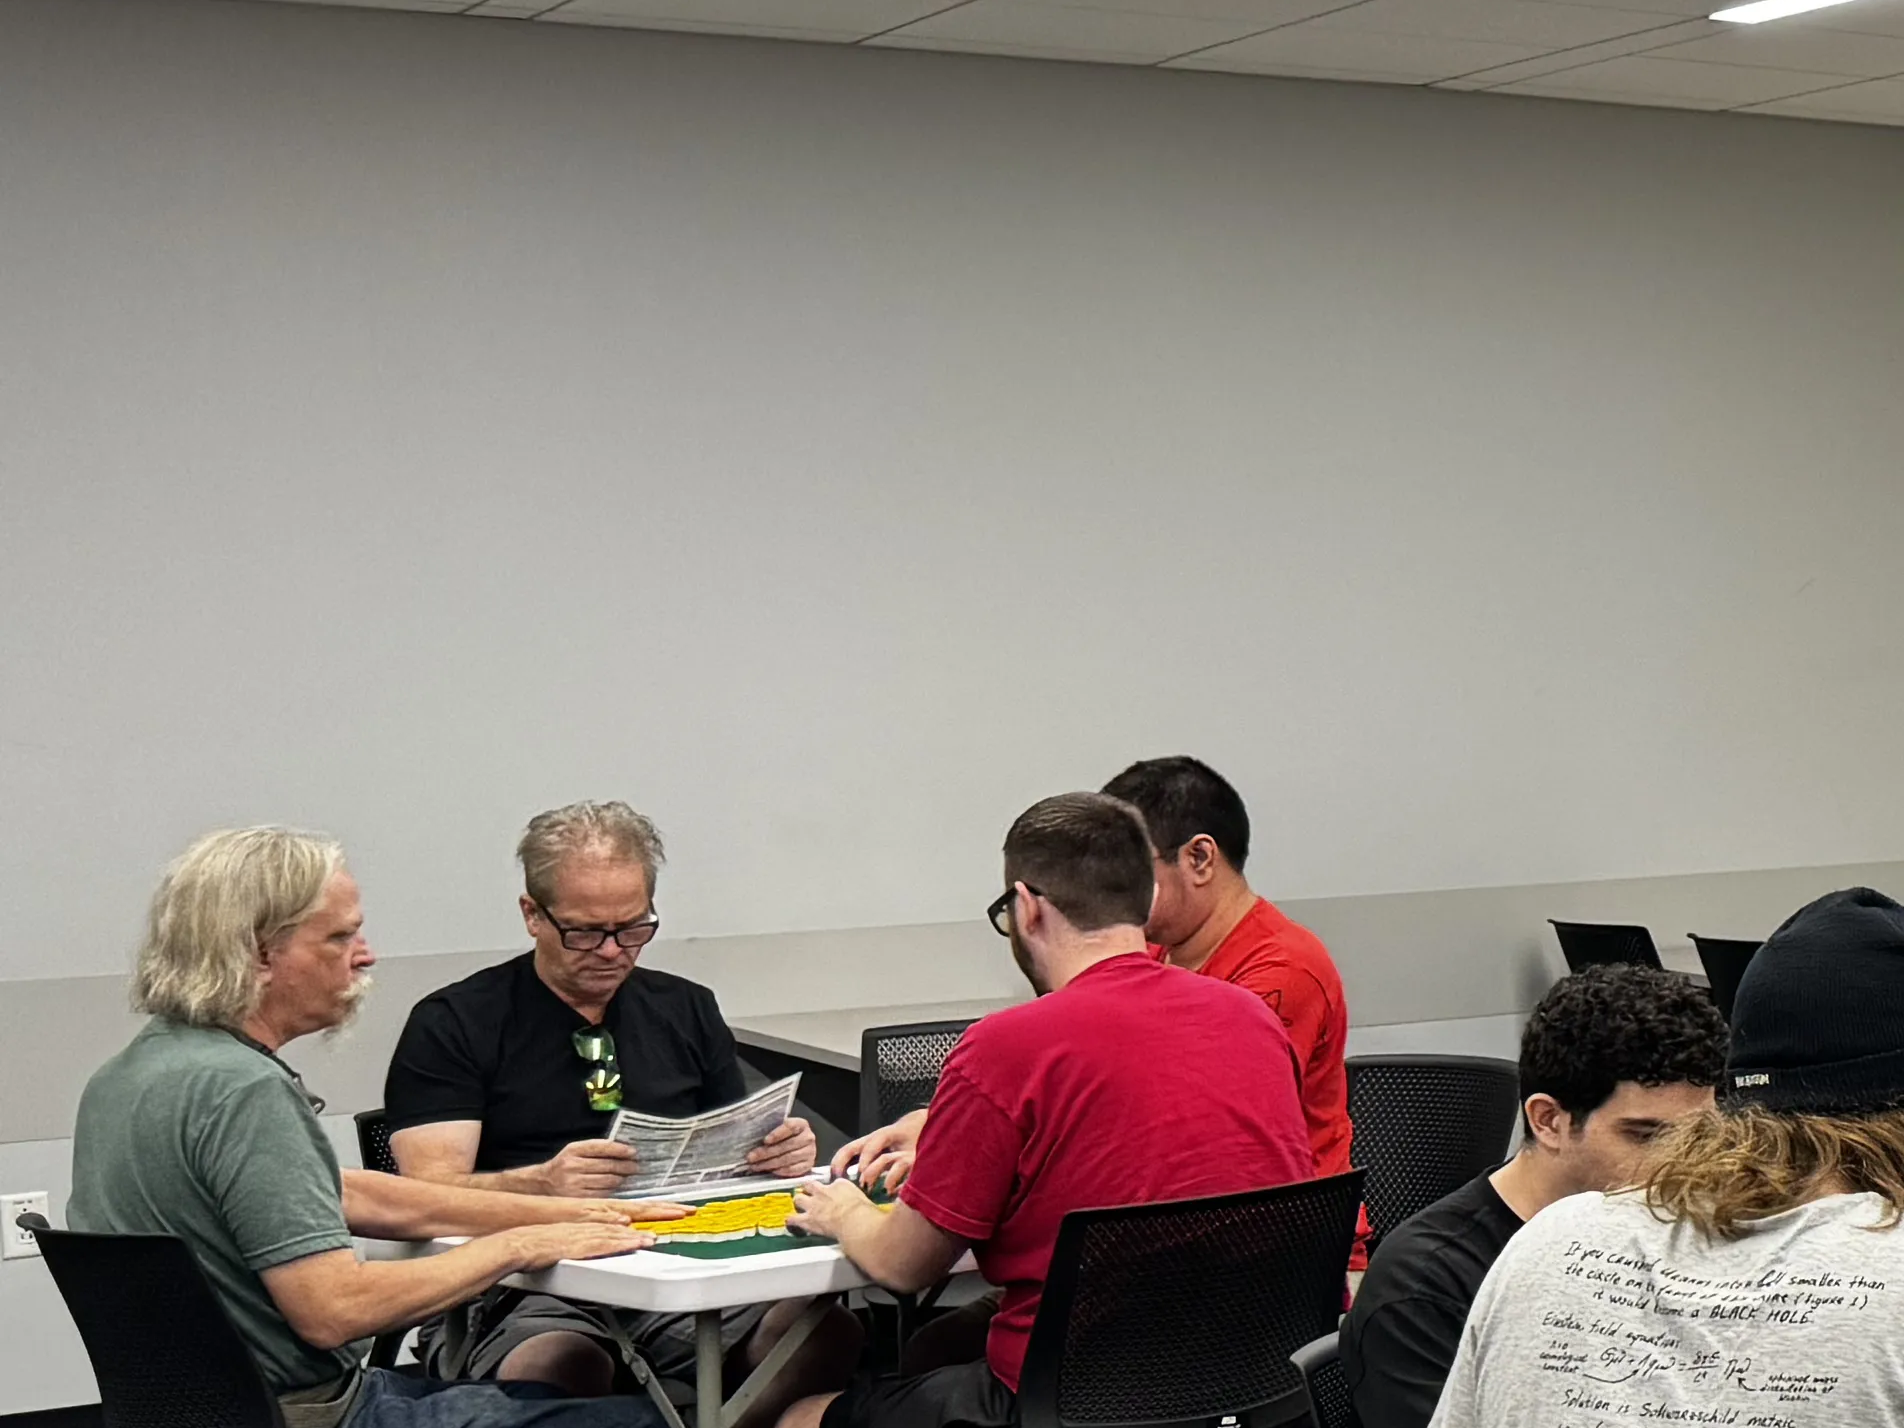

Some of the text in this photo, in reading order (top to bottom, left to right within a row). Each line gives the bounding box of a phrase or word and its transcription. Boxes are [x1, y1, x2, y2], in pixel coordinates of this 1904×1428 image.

[1581, 1247, 1605, 1261] you
[1850, 1275, 1885, 1290] than
[1709, 1304, 1760, 1320] BLACK
